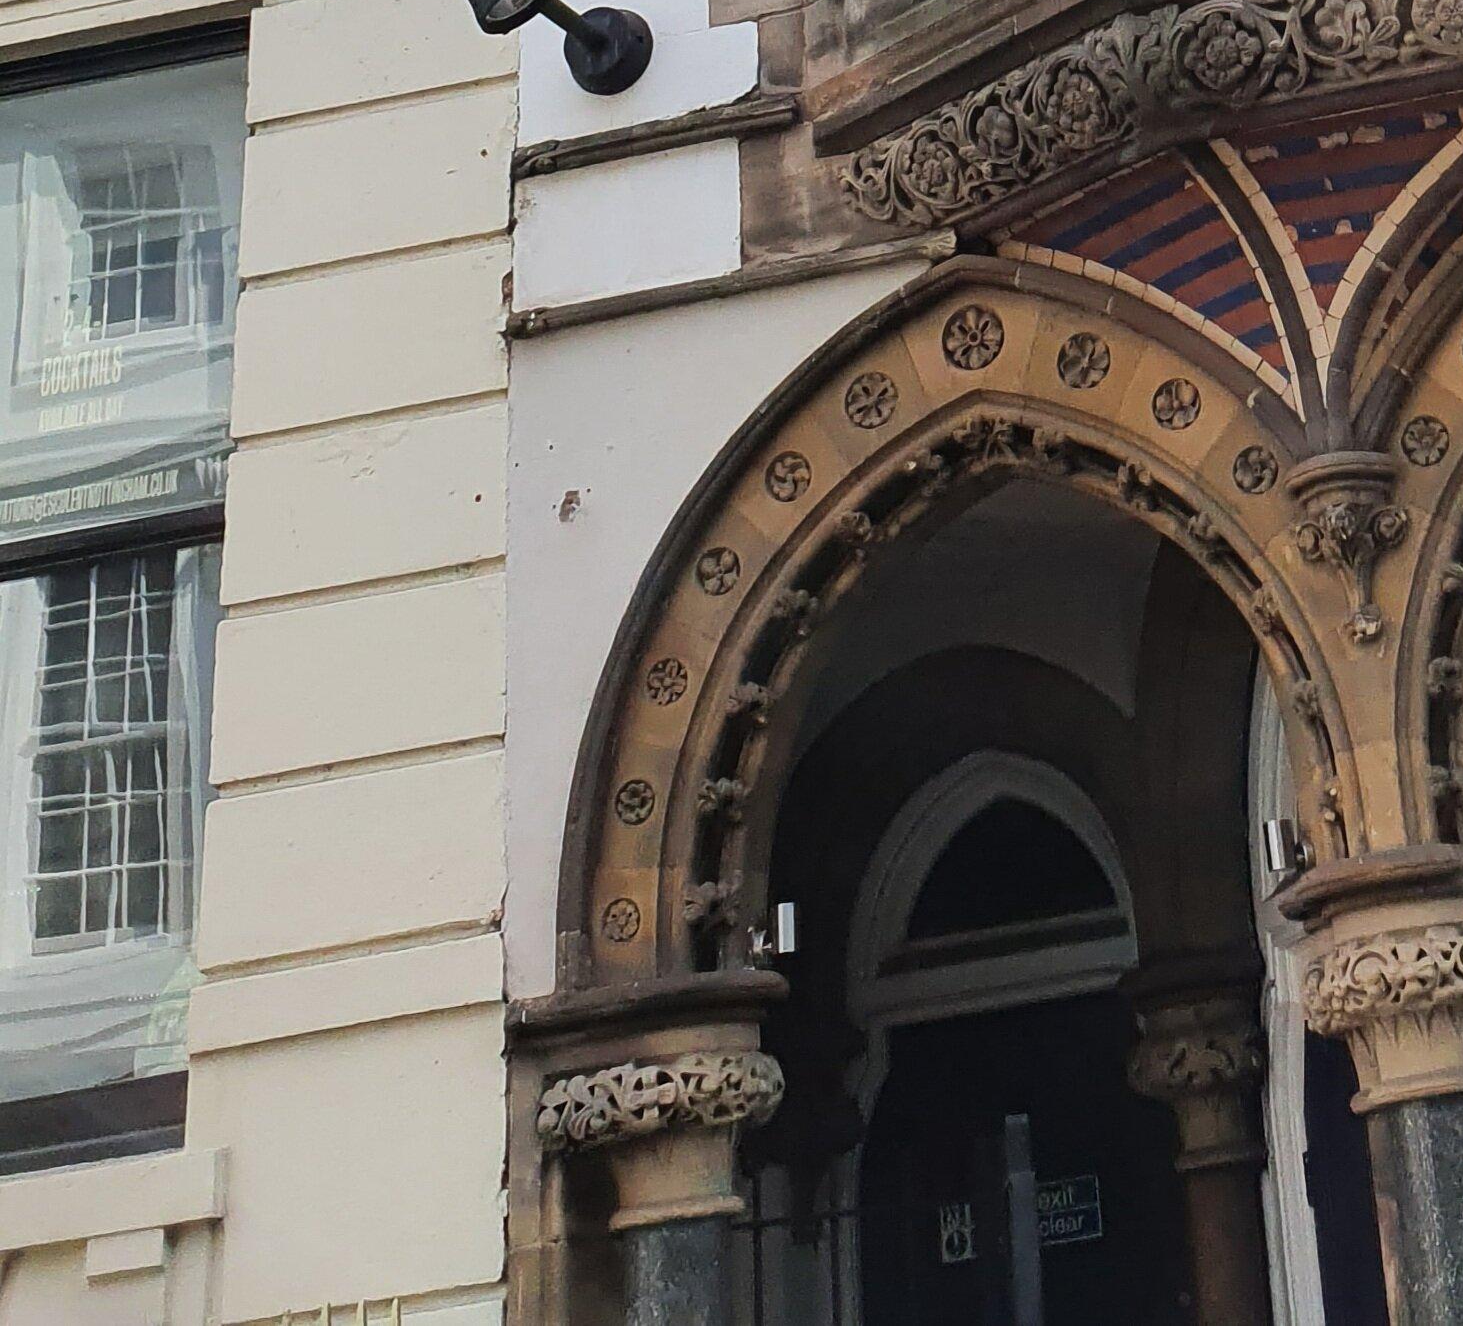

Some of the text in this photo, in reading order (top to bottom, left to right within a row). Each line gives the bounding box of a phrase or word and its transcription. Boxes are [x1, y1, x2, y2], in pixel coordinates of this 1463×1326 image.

[40, 345, 124, 397] COCKTAILS
[1038, 1183, 1074, 1209] exit
[1039, 1214, 1084, 1237] clear
